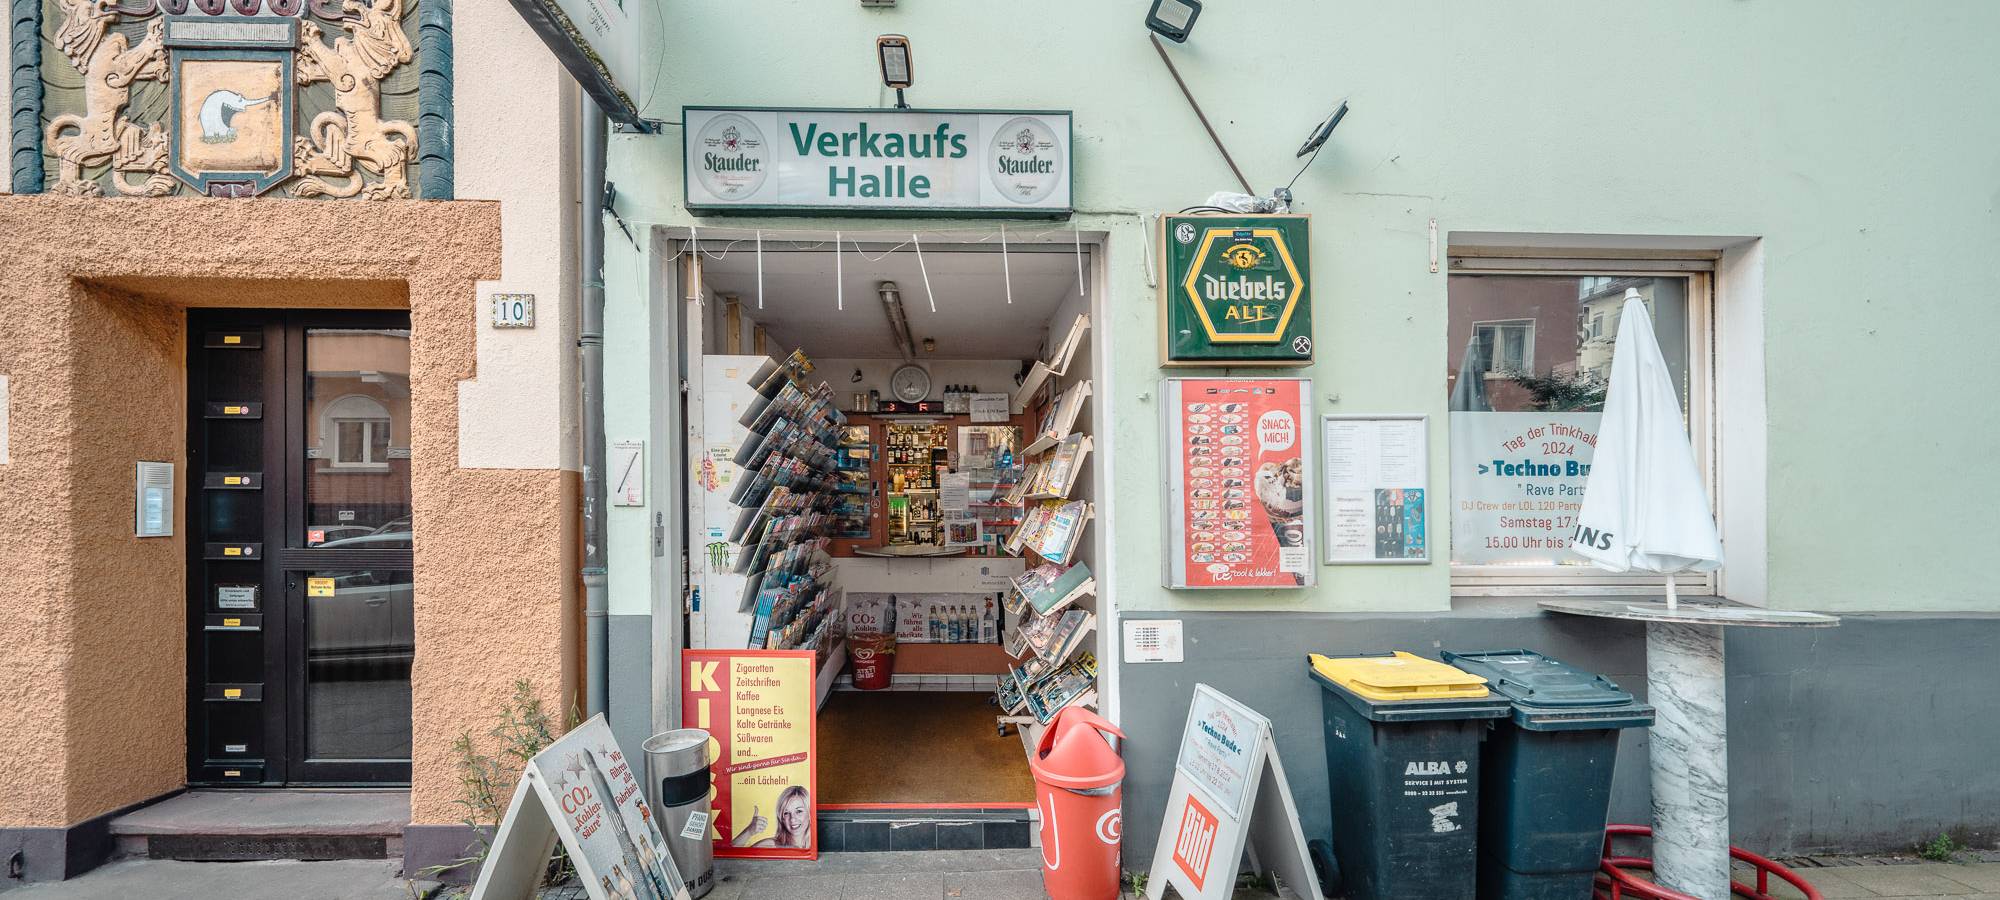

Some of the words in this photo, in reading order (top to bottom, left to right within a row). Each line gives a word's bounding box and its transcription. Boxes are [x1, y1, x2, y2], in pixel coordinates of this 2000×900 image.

[789, 122, 968, 158] Verkaufs
[829, 165, 931, 199] Halle
[502, 302, 523, 320] 10
[1224, 304, 1265, 321] ALT
[1262, 418, 1291, 430] SNACK
[1502, 434, 1526, 453] Tag
[1527, 427, 1545, 441] der
[1542, 441, 1574, 456] 2024
[1493, 459, 1561, 477] Techno
[1526, 484, 1554, 496] Rave
[1462, 501, 1474, 511] DJ
[1477, 501, 1499, 511] Crew
[1502, 501, 1516, 511] der
[1518, 501, 1534, 511] LOL
[1538, 501, 1555, 511] 120
[1500, 516, 1552, 531] Samstag
[1485, 536, 1518, 549] 15.00
[1522, 536, 1542, 549] Uhr
[1546, 536, 1564, 549] bis
[852, 614, 875, 624] CO2
[736, 663, 774, 675] Zigaretten
[736, 676, 781, 687] Zeitschriften
[736, 690, 760, 701] Kaffee
[736, 705, 772, 717] Langnese
[773, 705, 784, 715] Eis
[736, 719, 756, 729] Kalte
[757, 719, 792, 729] Getränke
[736, 732, 774, 743] Süßwaren
[1201, 720, 1222, 741] Techno
[1220, 734, 1237, 753] Bude
[610, 751, 622, 763] Wir
[737, 747, 758, 757] und...
[738, 763, 753, 771] sind
[753, 761, 770, 770] gerne
[770, 758, 781, 766] für
[781, 756, 790, 764] Sie
[1405, 761, 1452, 776] ALBA
[609, 762, 627, 780] führen
[623, 771, 633, 784] alle
[757, 775, 789, 785] Lächeln!
[561, 785, 593, 815] CO2
[614, 783, 638, 808] Fabrikate
[1178, 804, 1215, 880] Bild
